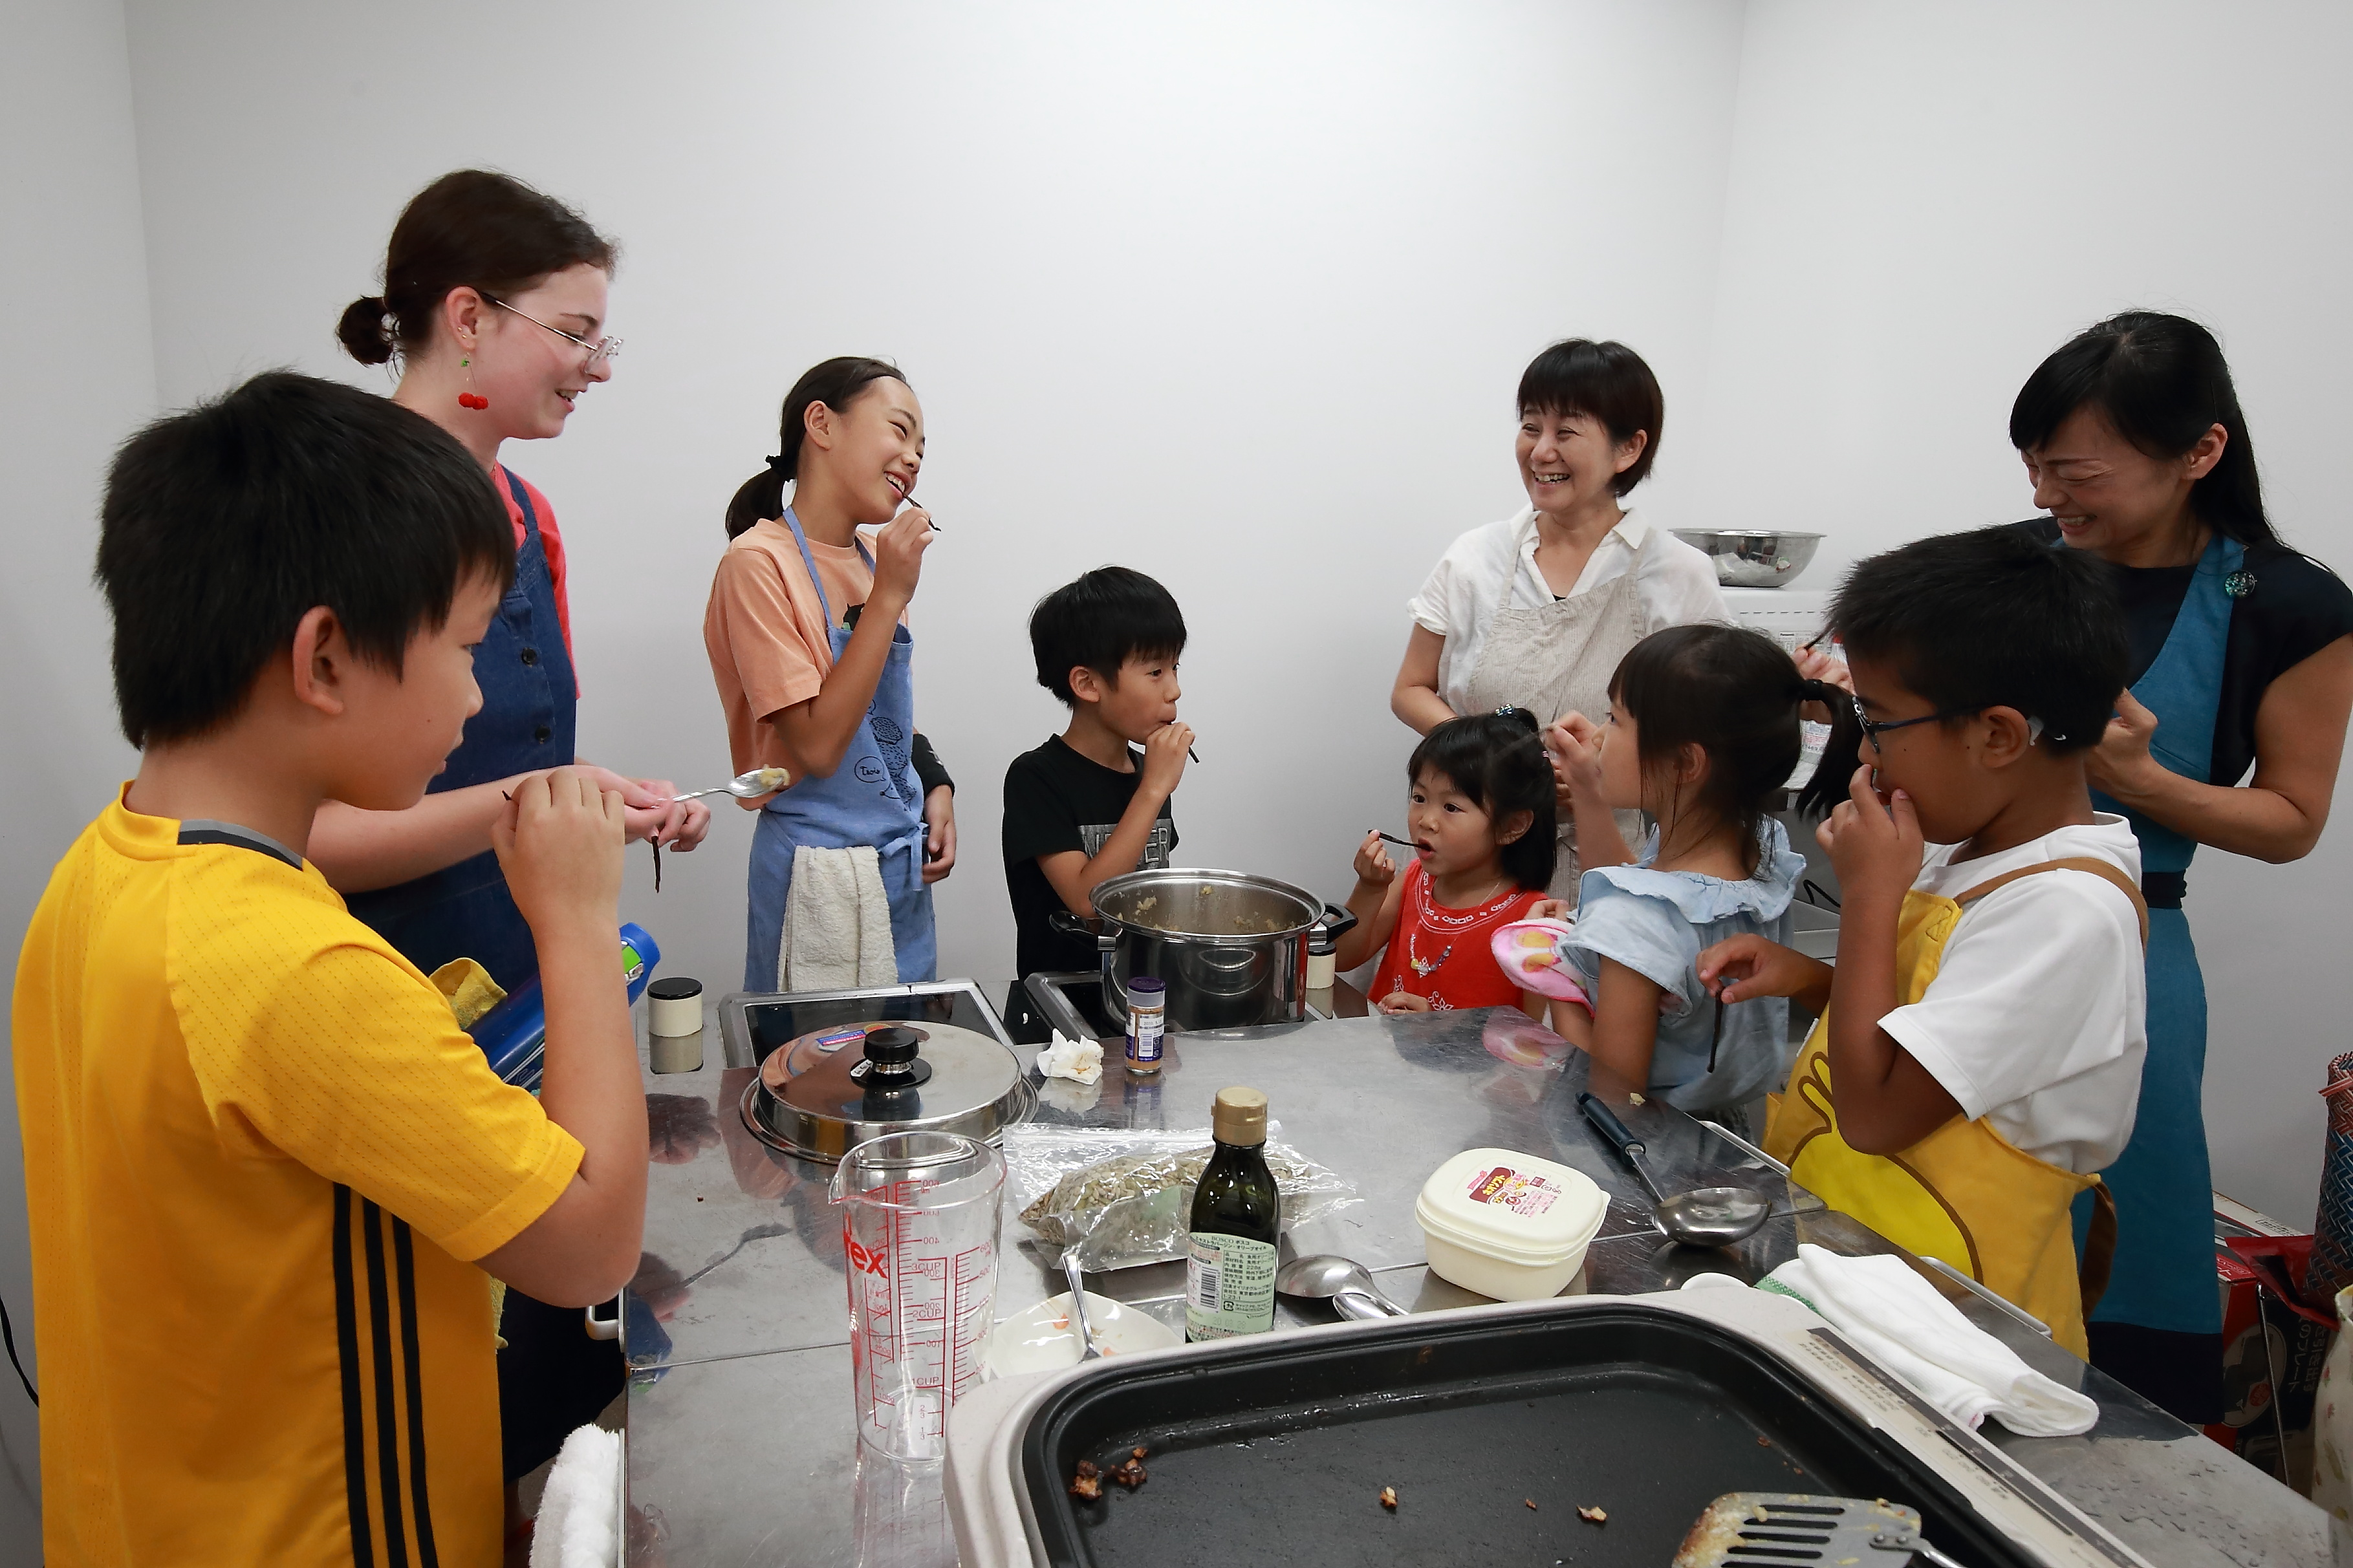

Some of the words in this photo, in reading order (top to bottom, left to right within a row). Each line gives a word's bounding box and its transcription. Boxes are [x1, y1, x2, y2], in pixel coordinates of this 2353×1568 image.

[1211, 1236, 1234, 1244] BOSCO
[911, 1262, 941, 1271] 3CUP
[912, 1309, 942, 1318] 2CUP
[912, 1376, 940, 1386] 1CUP
